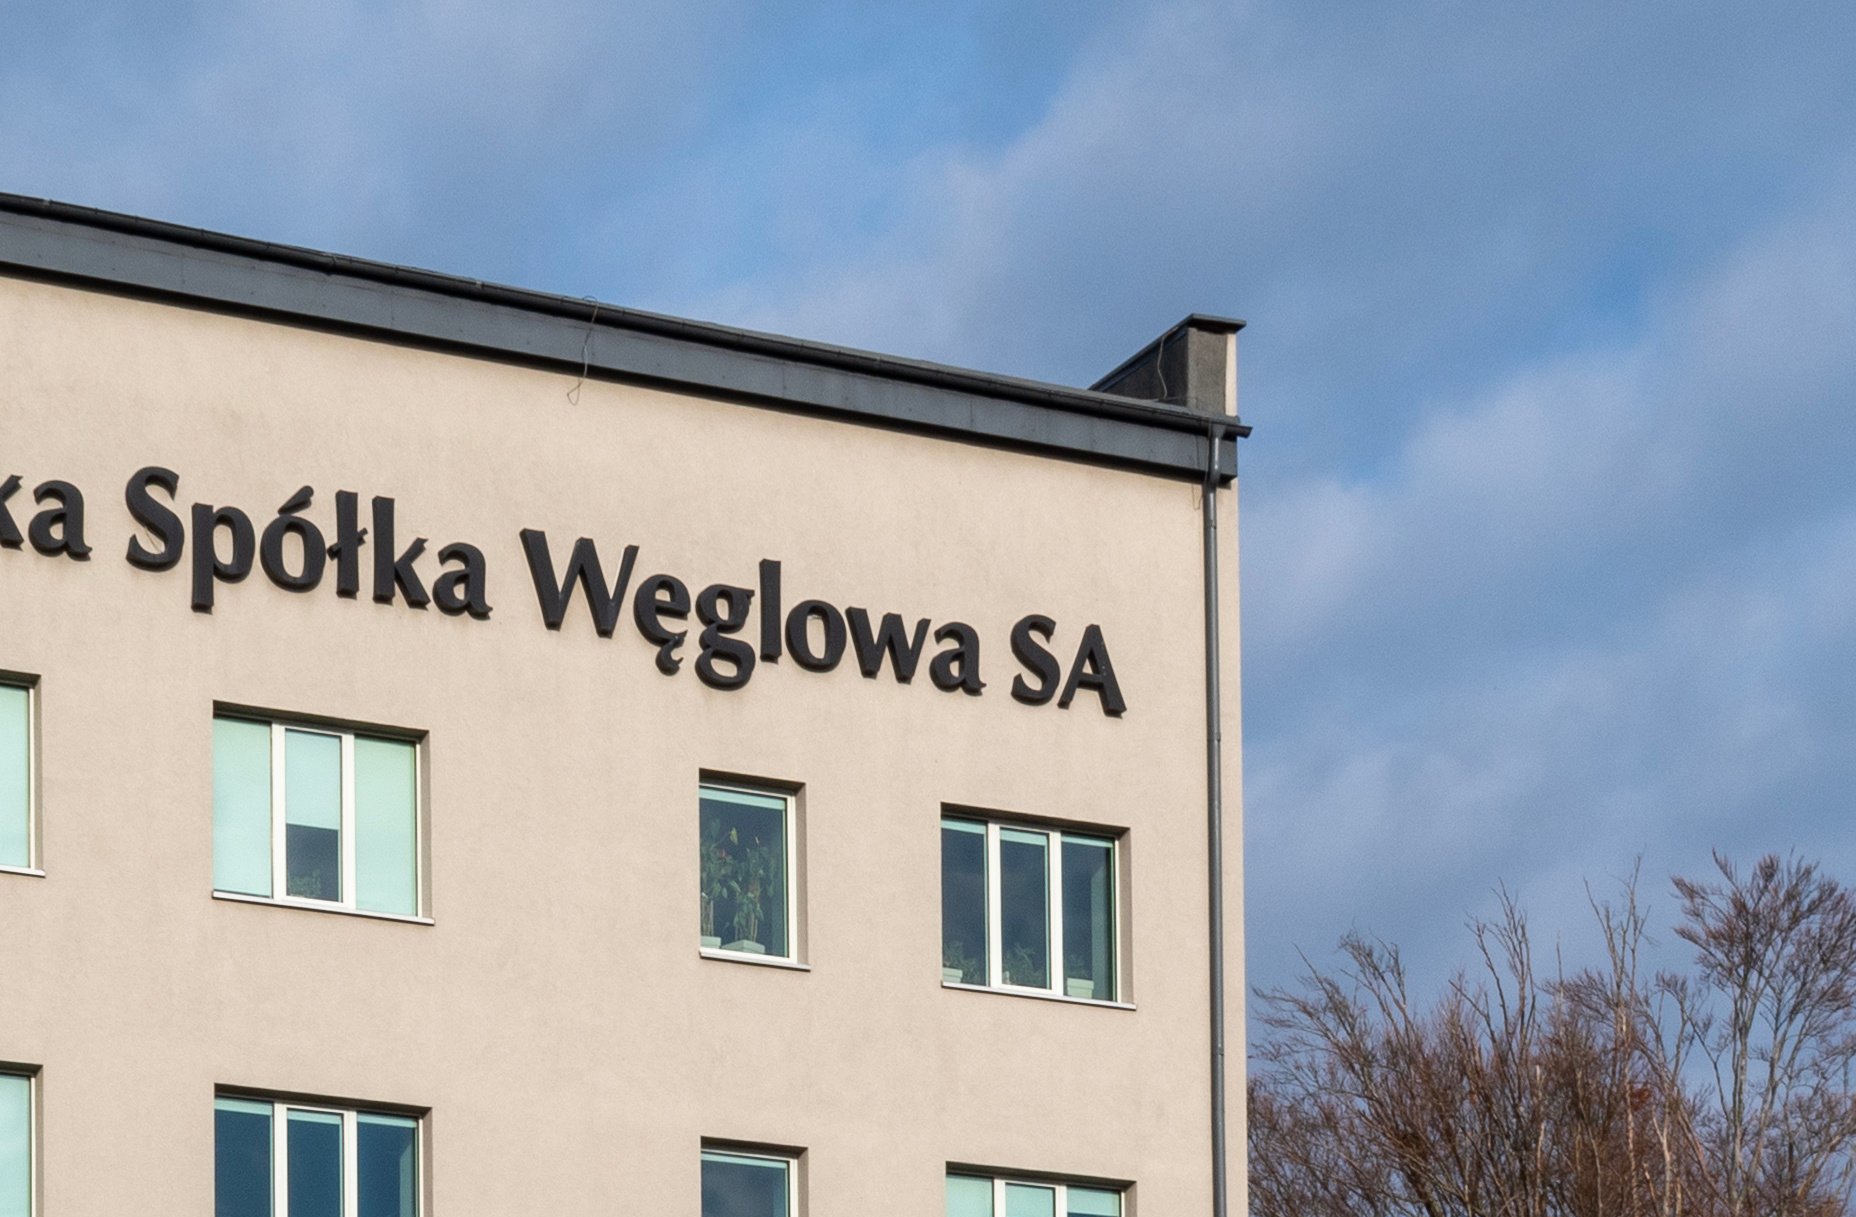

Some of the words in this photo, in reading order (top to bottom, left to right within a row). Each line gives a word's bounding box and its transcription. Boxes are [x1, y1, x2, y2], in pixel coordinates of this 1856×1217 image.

[124, 465, 494, 622] Spółka
[518, 527, 987, 698] Węglowa
[1009, 613, 1128, 719] SA
